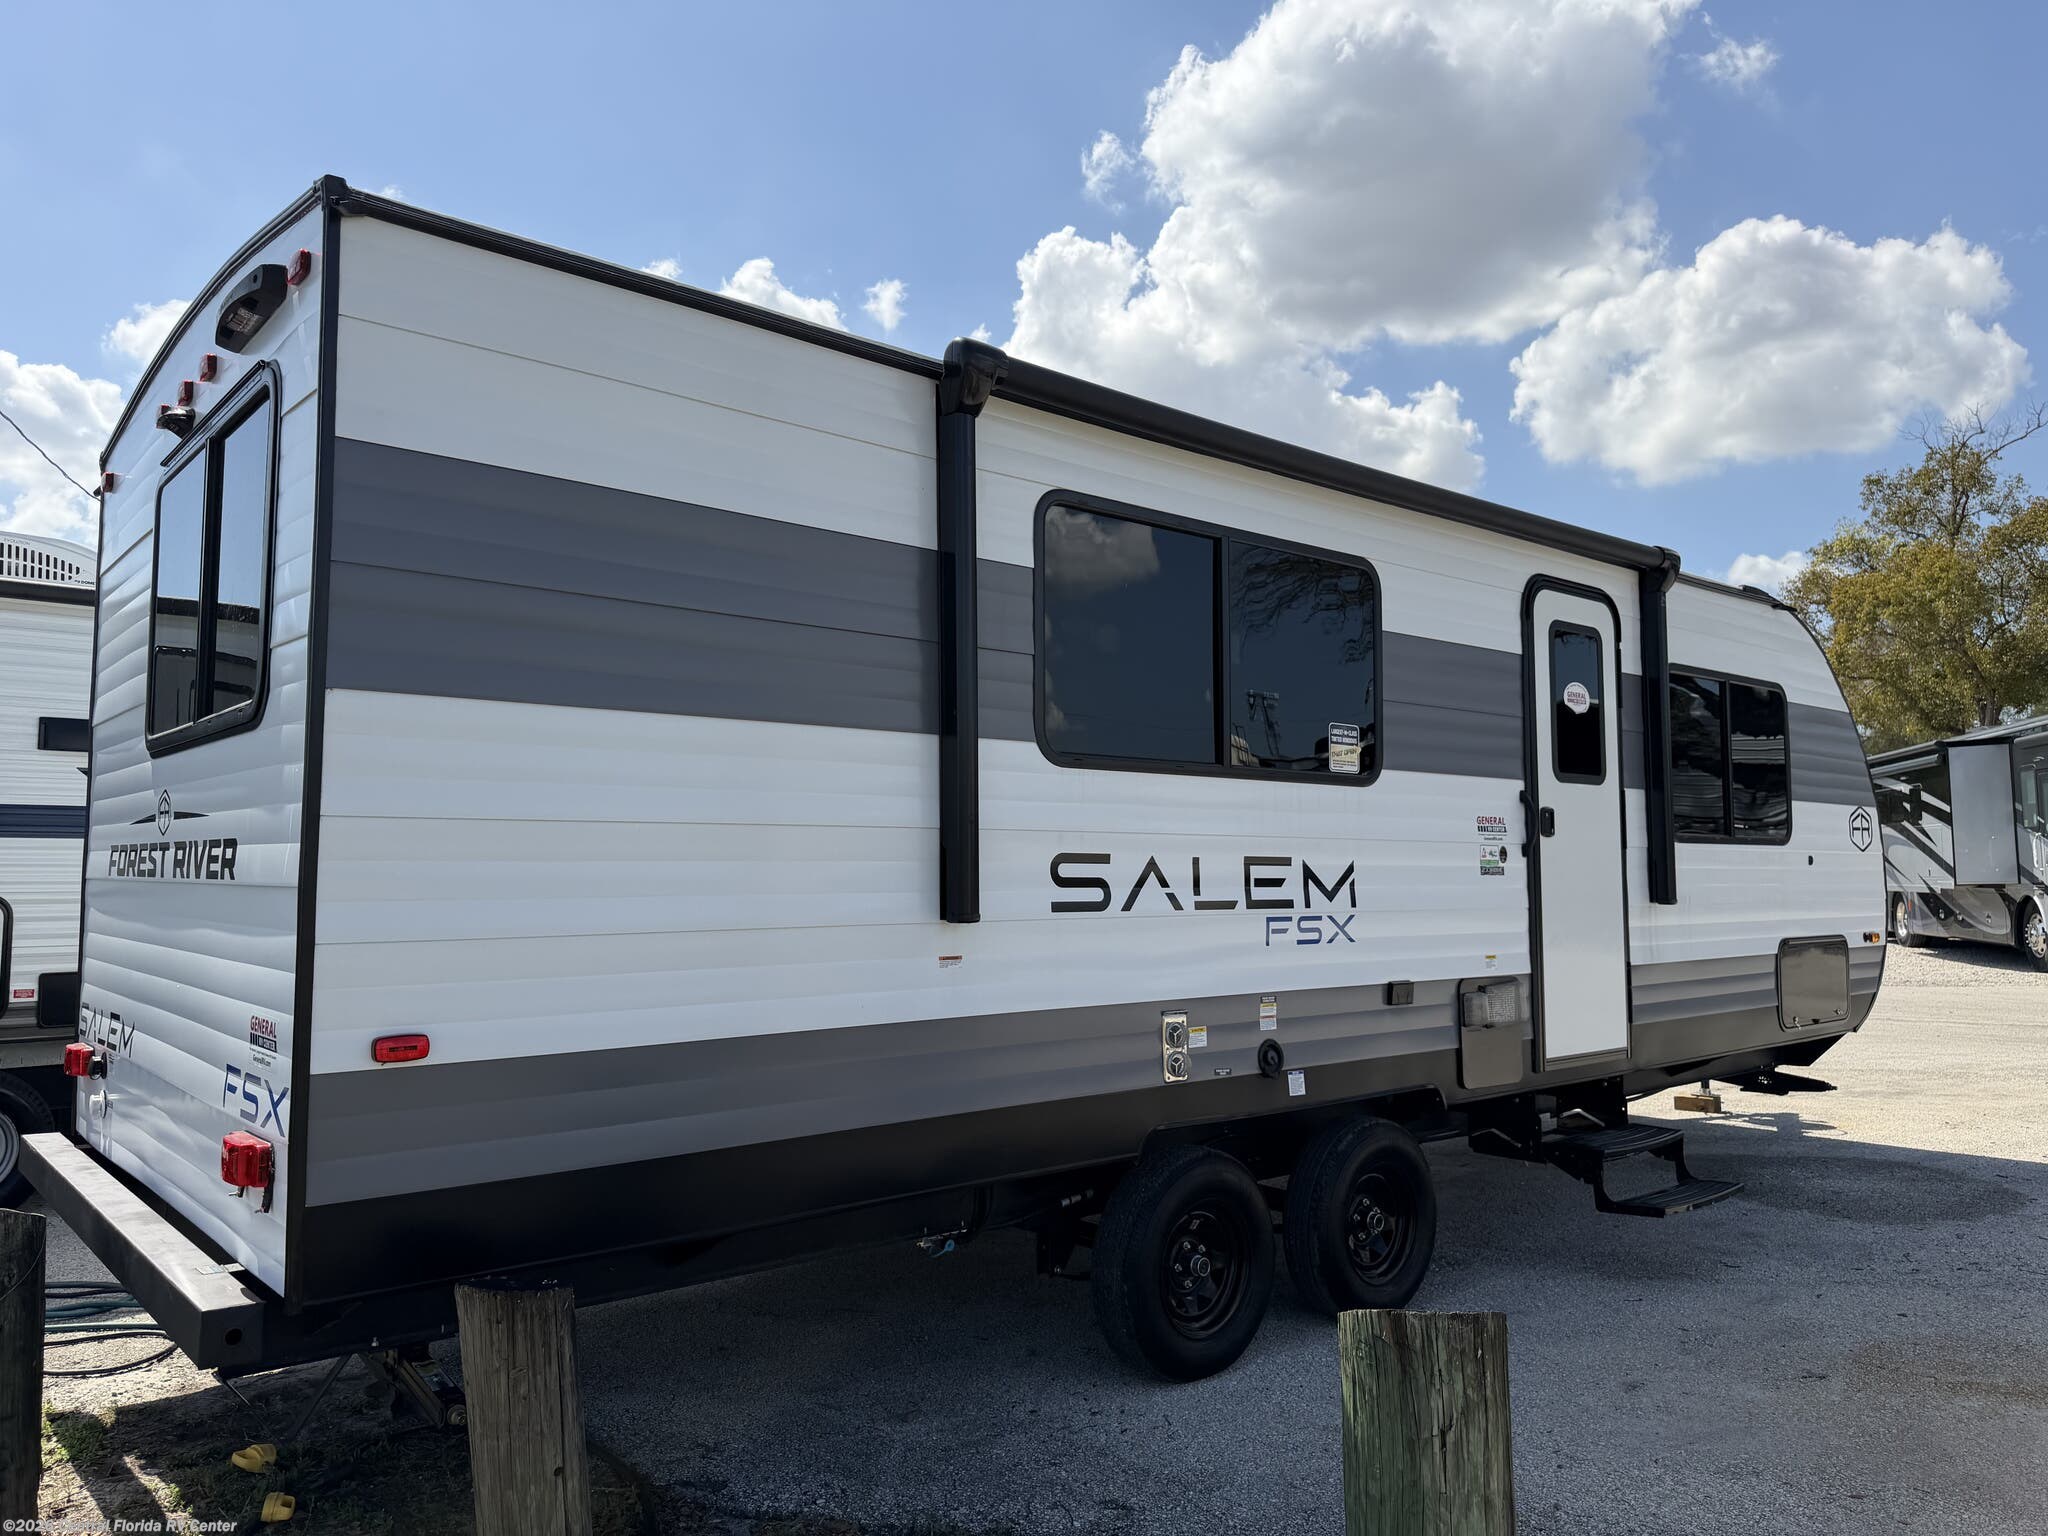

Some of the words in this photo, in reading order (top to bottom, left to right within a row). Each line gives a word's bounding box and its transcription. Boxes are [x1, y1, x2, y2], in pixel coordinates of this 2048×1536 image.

[1477, 816, 1506, 825] GENERAL
[108, 842, 170, 878] FOREST
[172, 838, 238, 880] RIVER
[1050, 852, 1357, 913] SALEM
[1265, 914, 1356, 946] FSX
[79, 1002, 136, 1058] SALEM
[250, 1015, 277, 1039] GENERAL
[223, 1063, 290, 1138] FSX
